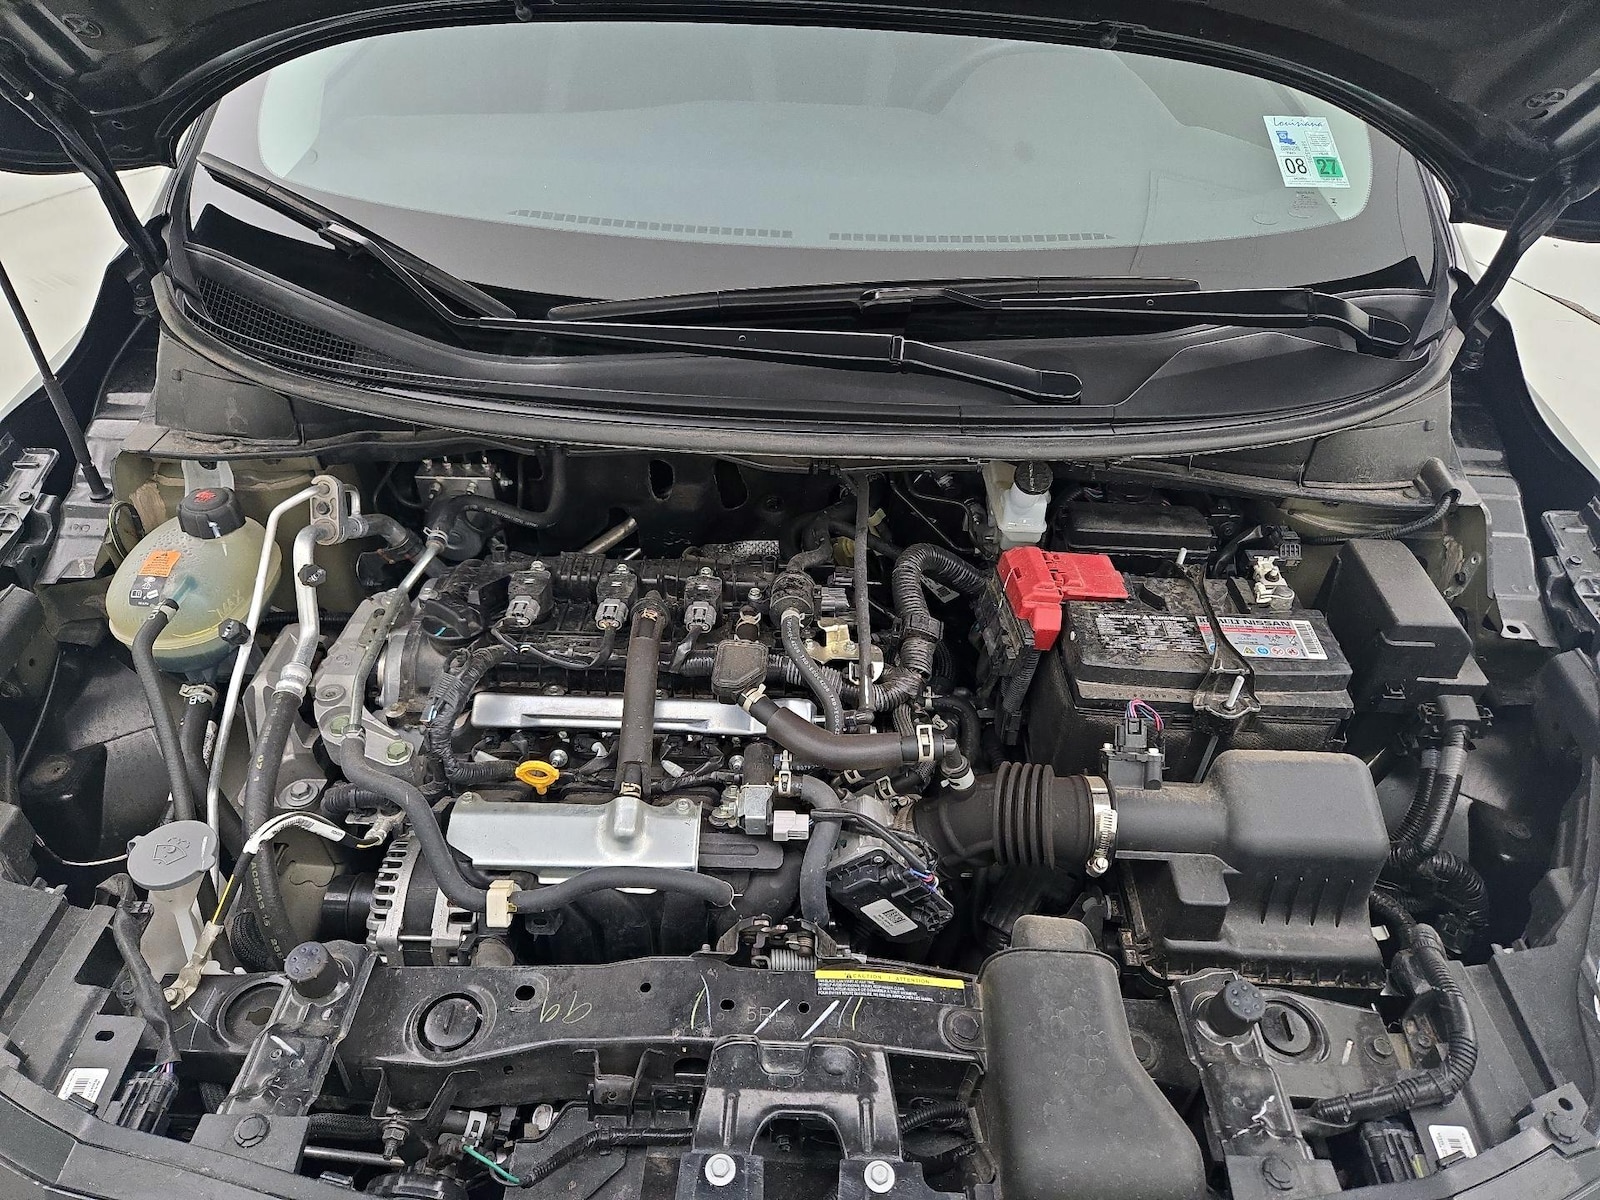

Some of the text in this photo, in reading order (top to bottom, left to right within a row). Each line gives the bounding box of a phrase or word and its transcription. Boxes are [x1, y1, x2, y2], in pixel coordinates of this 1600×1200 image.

[1273, 117, 1323, 127] Louisiana
[1285, 158, 1337, 175] 08 27
[1242, 619, 1291, 627] NISSAN
[896, 976, 930, 984] ATTENTION
